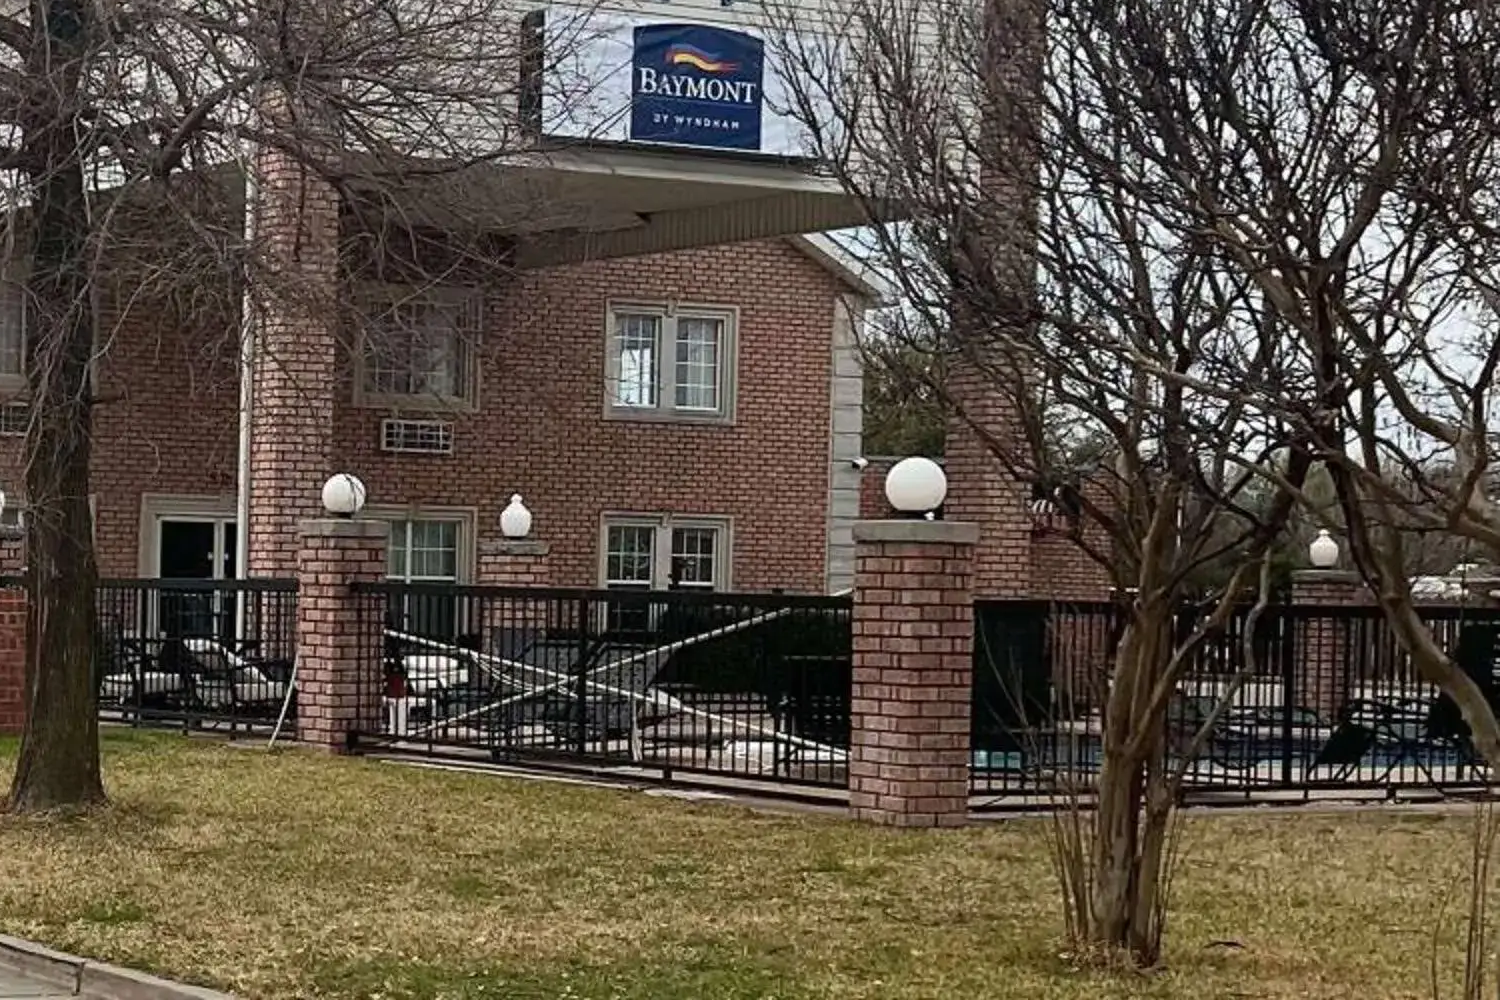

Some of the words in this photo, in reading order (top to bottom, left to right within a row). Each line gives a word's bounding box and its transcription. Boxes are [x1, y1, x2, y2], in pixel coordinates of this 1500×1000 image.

[638, 67, 756, 103] BAYMONT
[653, 113, 668, 123] BY
[674, 115, 740, 129] WYNDHAM
